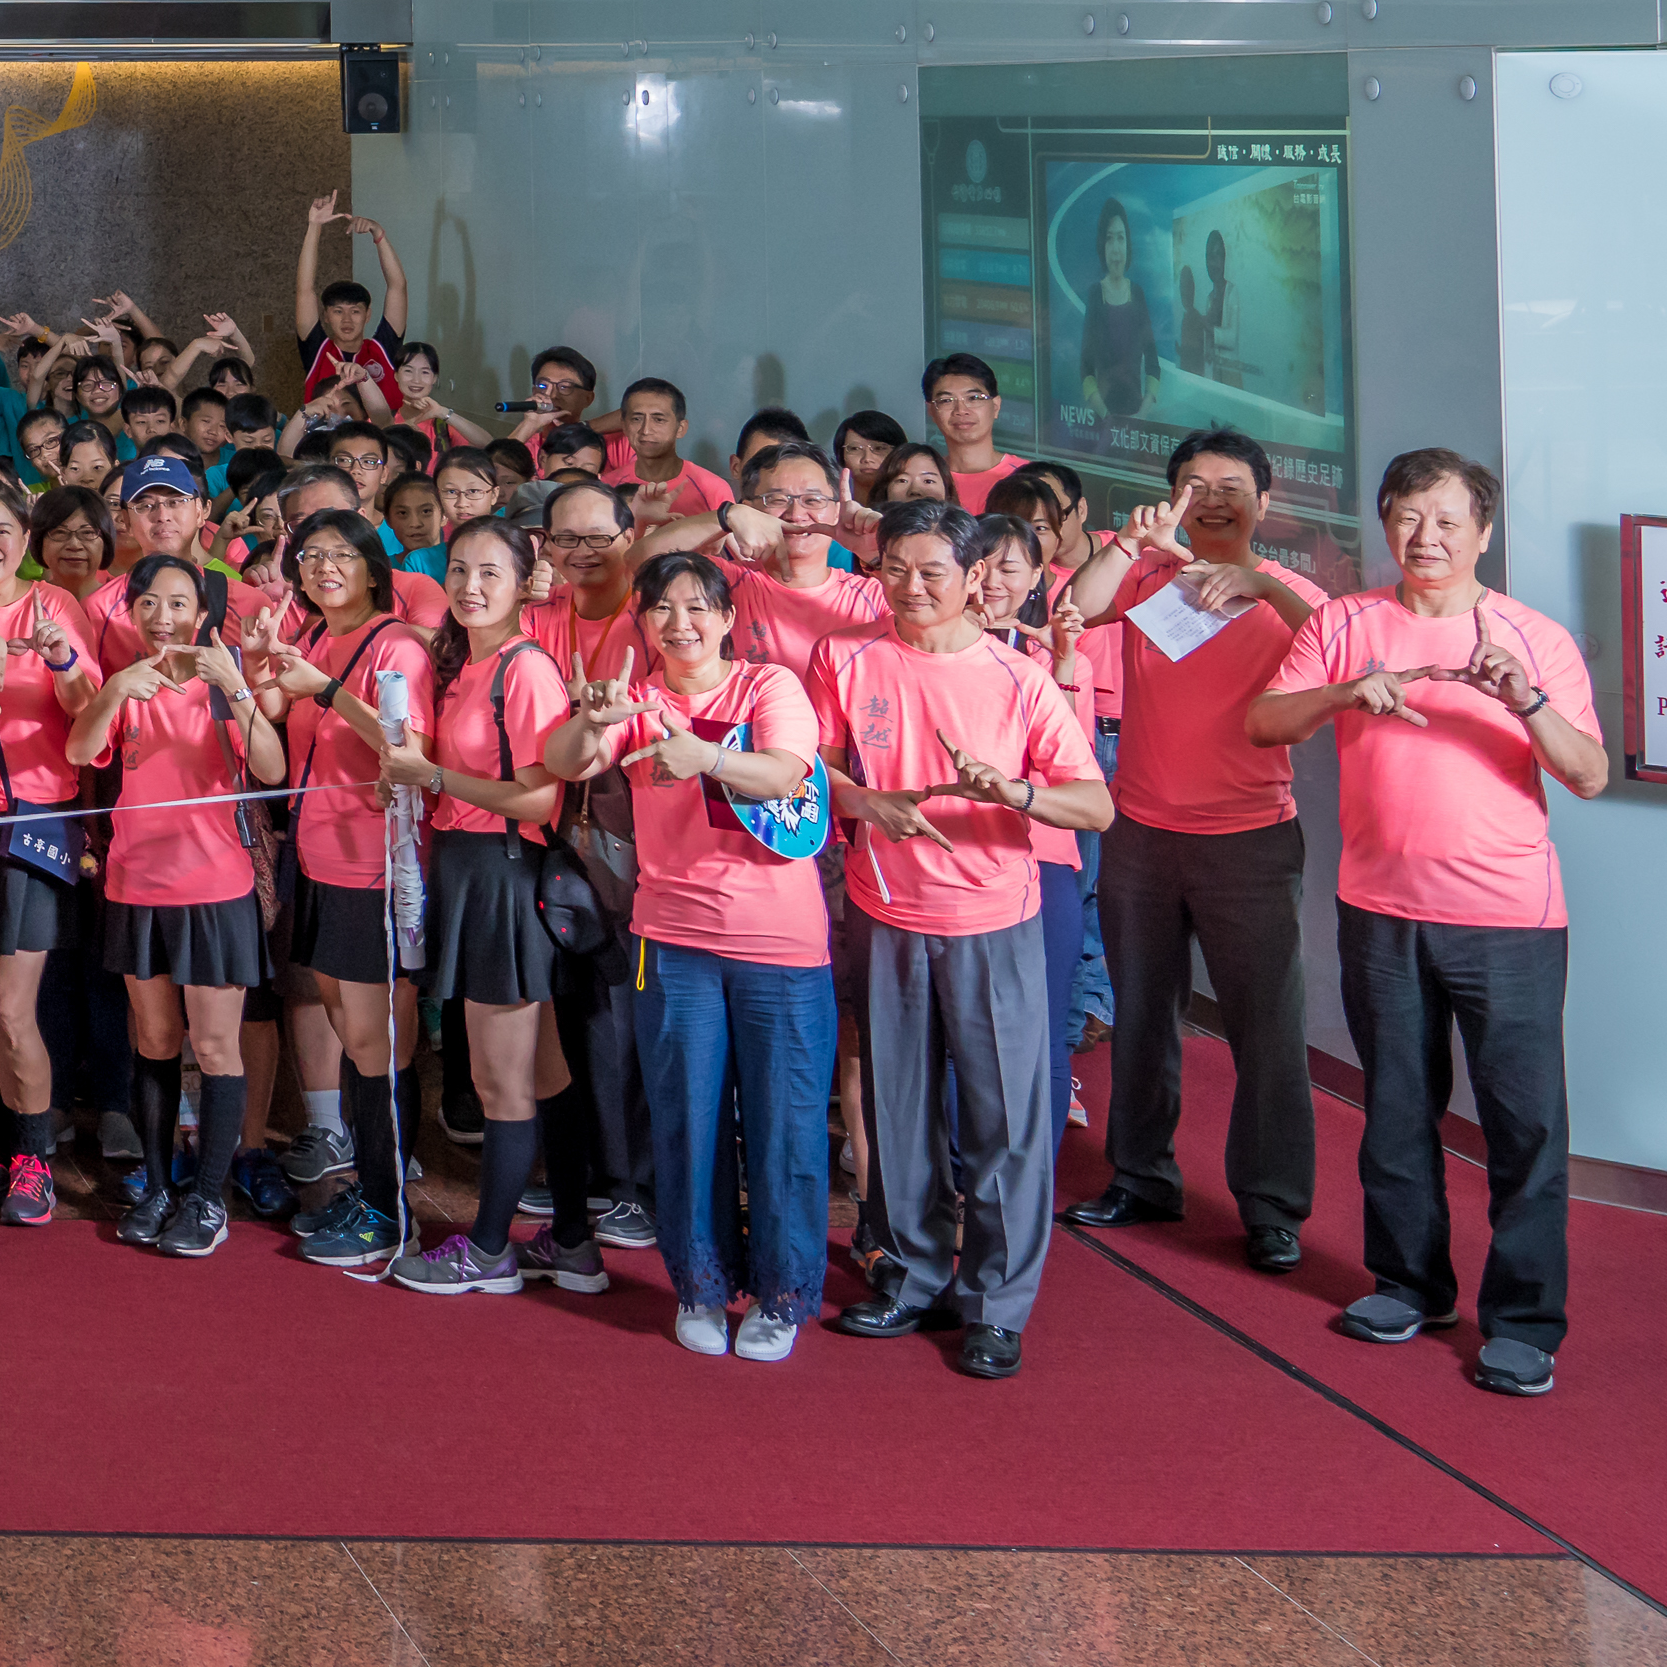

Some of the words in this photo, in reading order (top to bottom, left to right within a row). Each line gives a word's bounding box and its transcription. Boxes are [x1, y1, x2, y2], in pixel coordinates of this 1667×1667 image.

[1060, 404, 1095, 426] NEWS
[1267, 452, 1344, 490] 紀錄歷史足跡
[860, 695, 893, 749] 超越
[22, 833, 70, 865] 古亭國小
